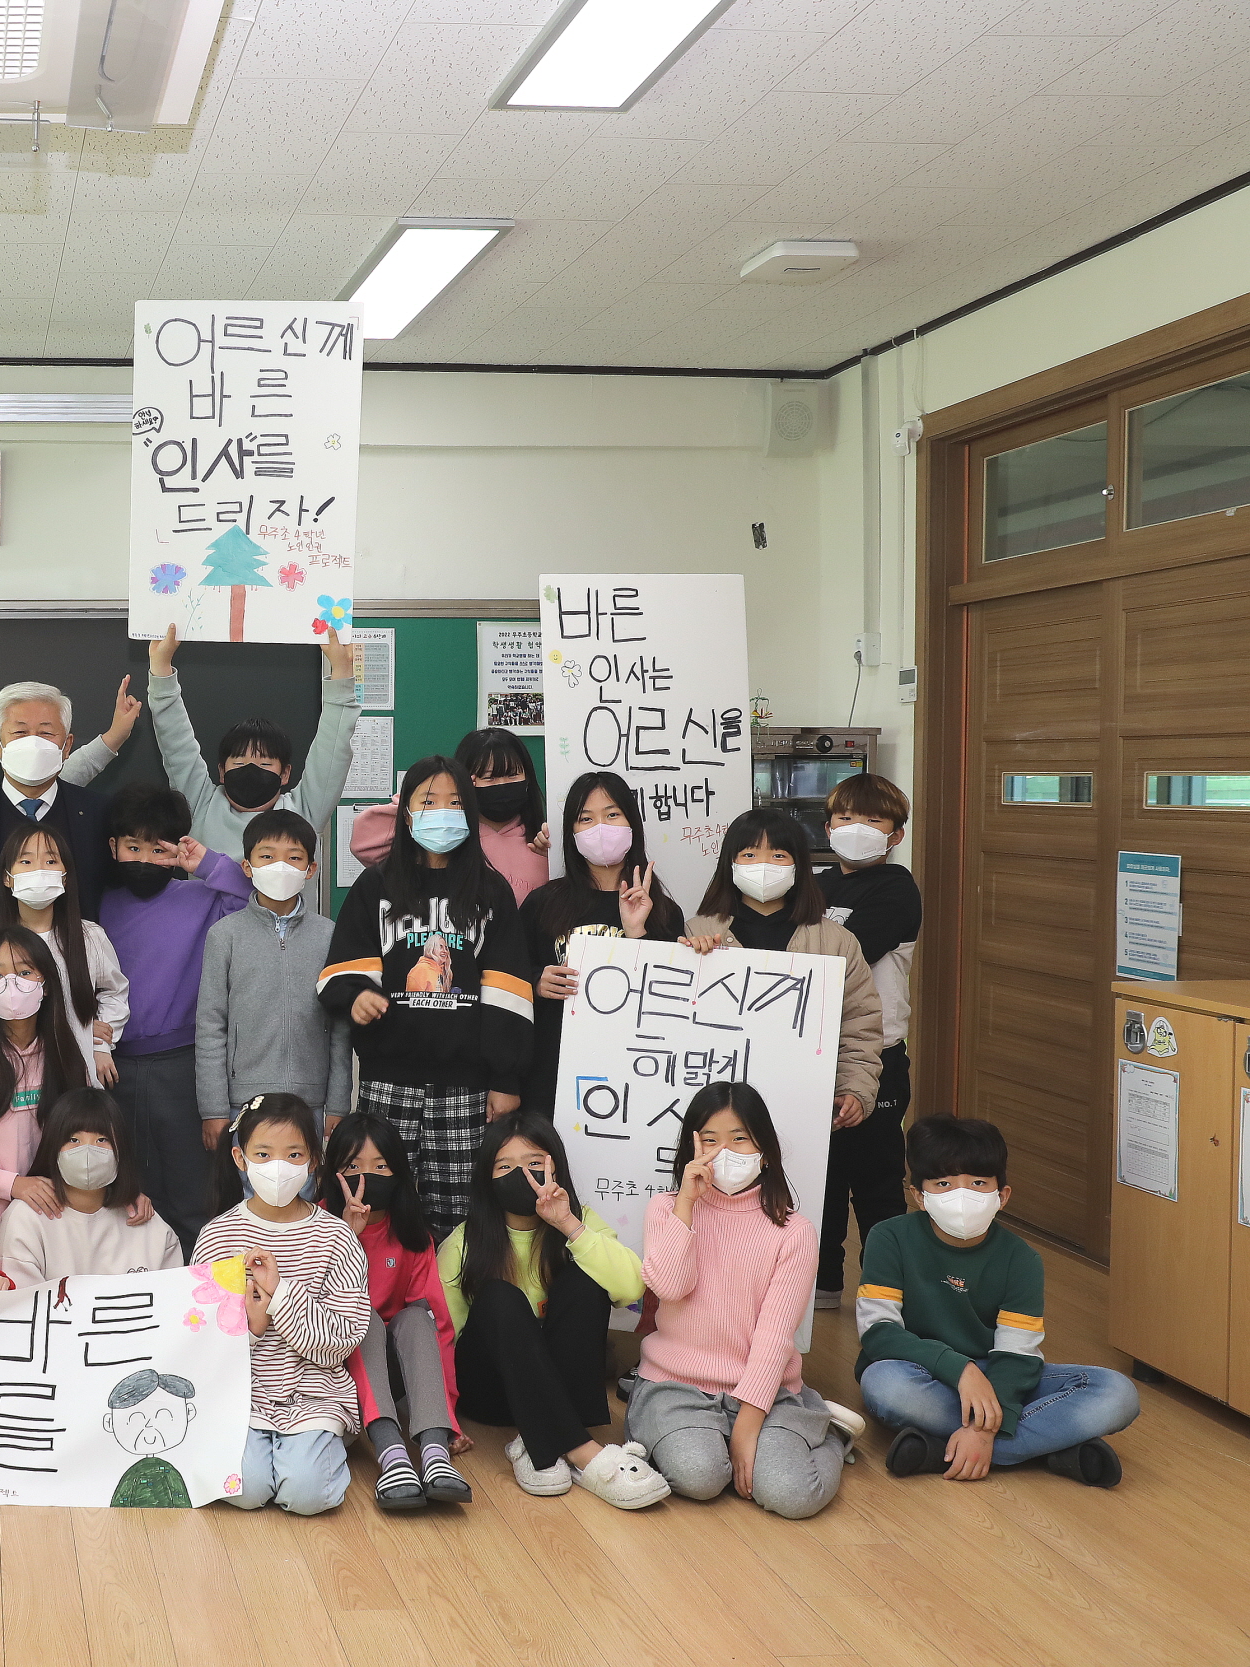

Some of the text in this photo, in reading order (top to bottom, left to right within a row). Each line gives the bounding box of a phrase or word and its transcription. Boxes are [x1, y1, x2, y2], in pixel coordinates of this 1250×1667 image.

[155, 314, 354, 374] 어르신께
[189, 368, 294, 427] 바른
[172, 495, 336, 536] 드리자!
[257, 524, 291, 541] 무주초
[308, 553, 353, 569] 프로젝트
[557, 586, 647, 643] 바른
[589, 654, 673, 703] 인사는
[583, 705, 743, 771] 어르신을
[412, 999, 454, 1008] EACH OTHER
[595, 1178, 640, 1202] 무주초
